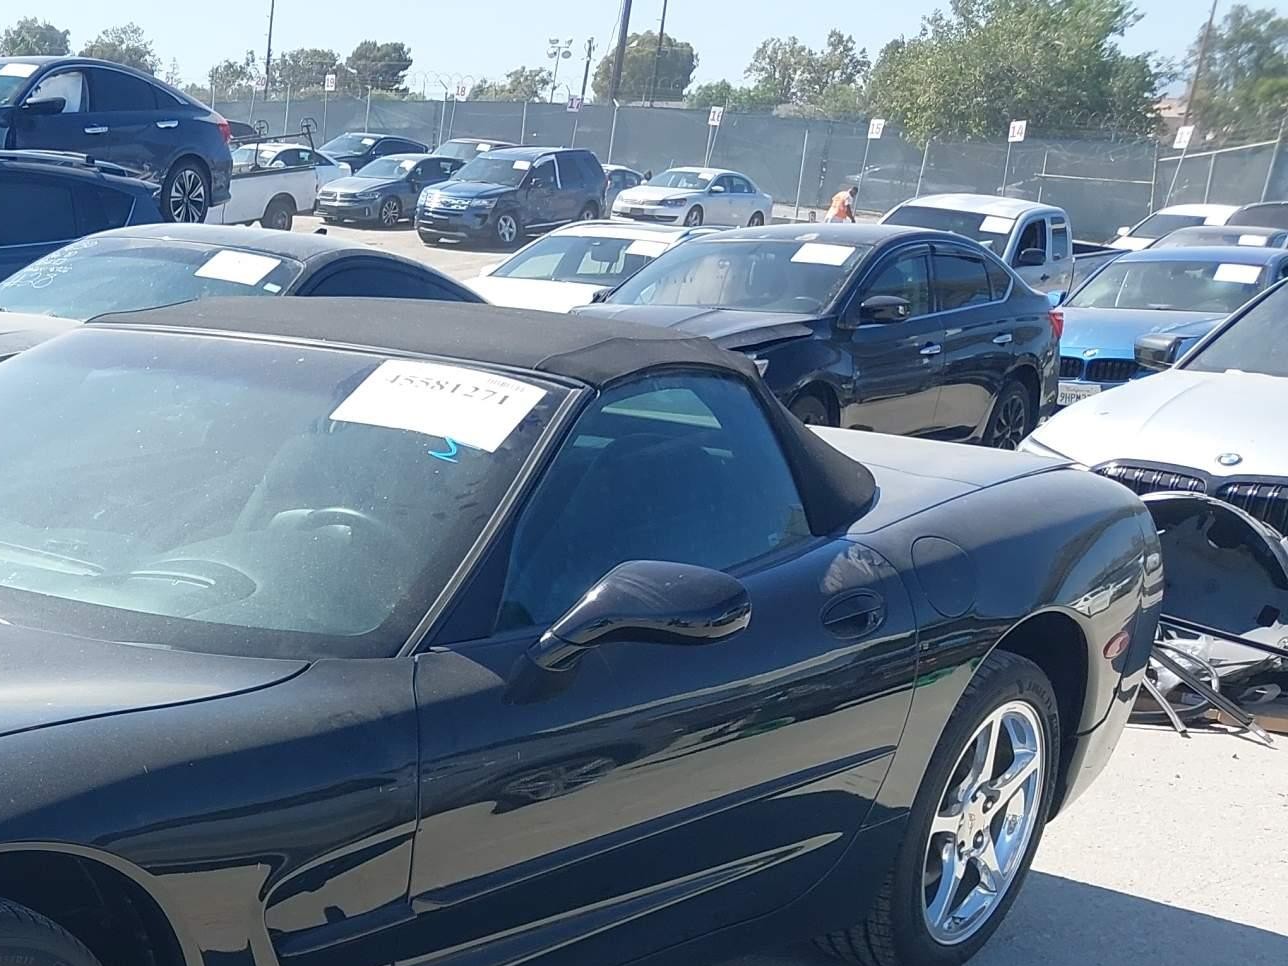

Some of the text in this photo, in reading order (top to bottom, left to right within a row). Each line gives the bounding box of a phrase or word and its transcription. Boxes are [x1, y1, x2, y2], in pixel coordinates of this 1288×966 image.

[255, 75, 266, 87] 20
[326, 77, 335, 88] 19
[455, 85, 466, 97] 18
[567, 97, 581, 110] 17
[871, 123, 882, 135] 15
[1010, 125, 1024, 139] 14
